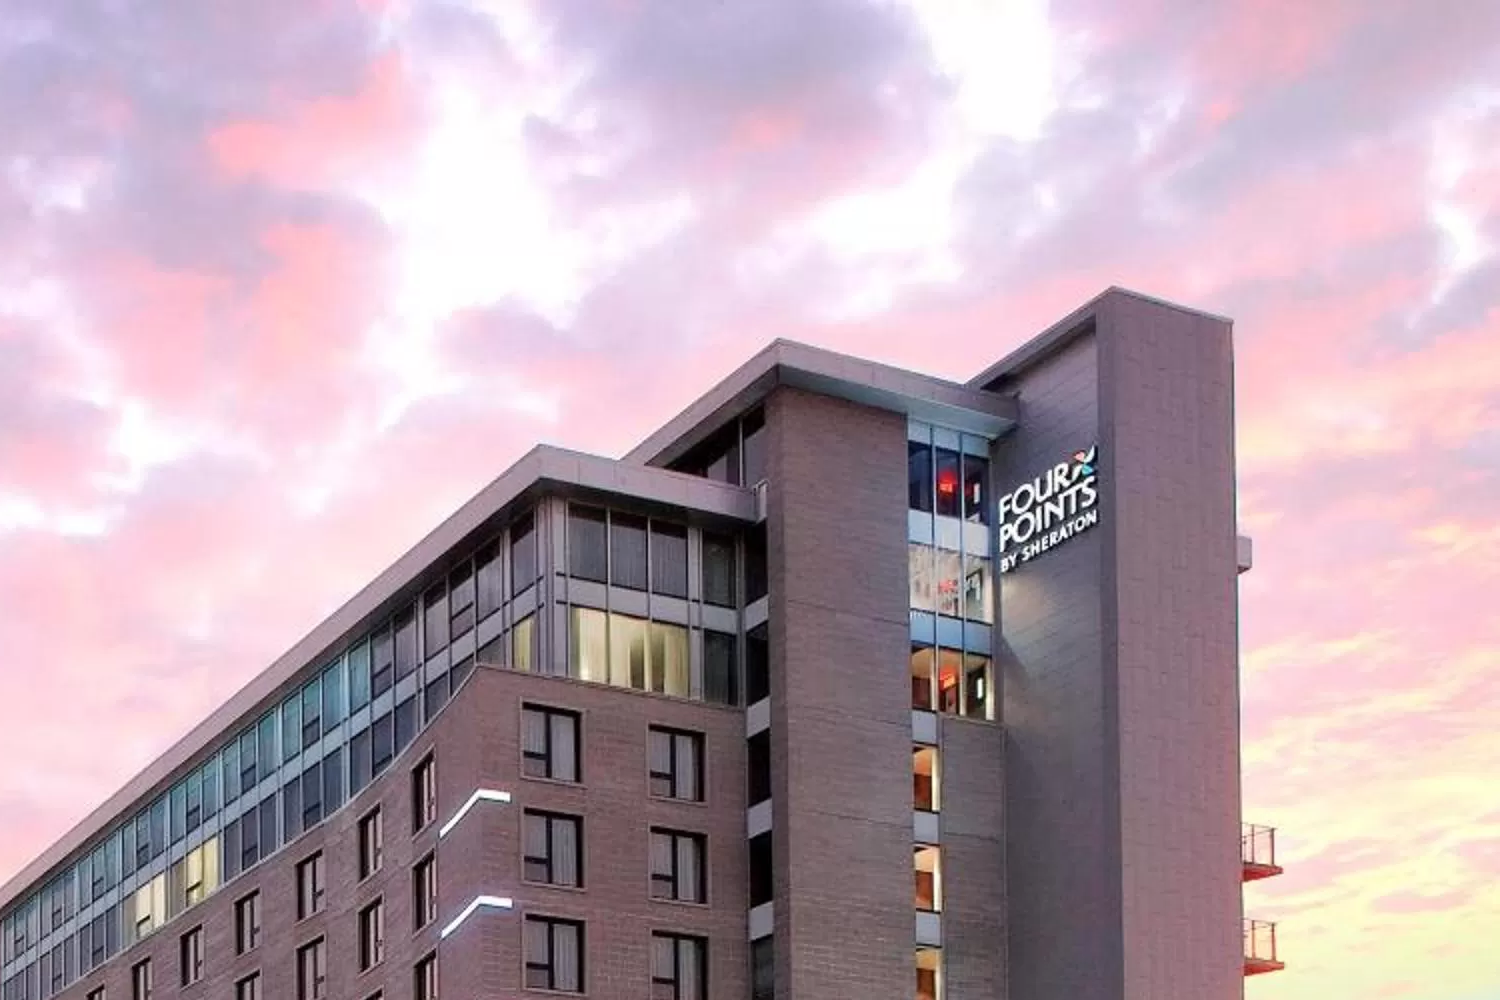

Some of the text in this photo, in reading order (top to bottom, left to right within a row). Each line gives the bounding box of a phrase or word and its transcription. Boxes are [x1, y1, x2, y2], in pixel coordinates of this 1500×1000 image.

[999, 462, 1070, 524] FOUR
[999, 475, 1097, 553] POINTS
[1000, 509, 1097, 573] BY SHERATON
